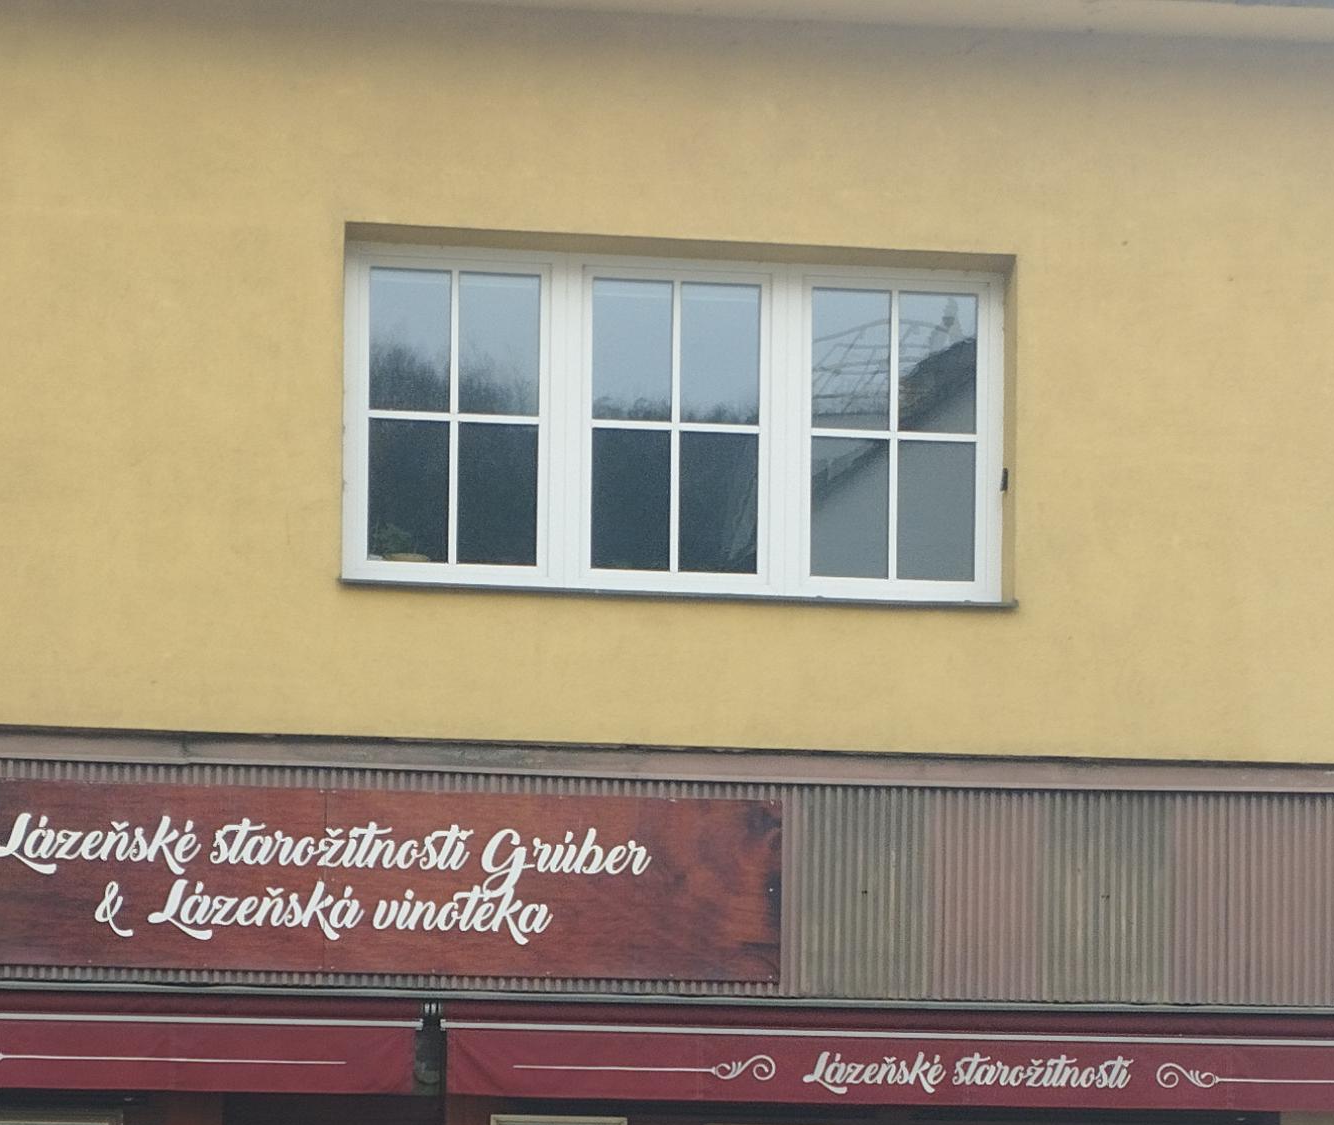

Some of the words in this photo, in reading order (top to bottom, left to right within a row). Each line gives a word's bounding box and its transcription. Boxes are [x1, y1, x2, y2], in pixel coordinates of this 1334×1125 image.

[210, 818, 474, 870] starožitnosti
[94, 881, 133, 937] &
[147, 879, 365, 941] Lázeňská
[373, 884, 554, 945] vinotéka
[803, 1051, 946, 1094] Lázeňské
[953, 1052, 1134, 1088] starožitnosti
